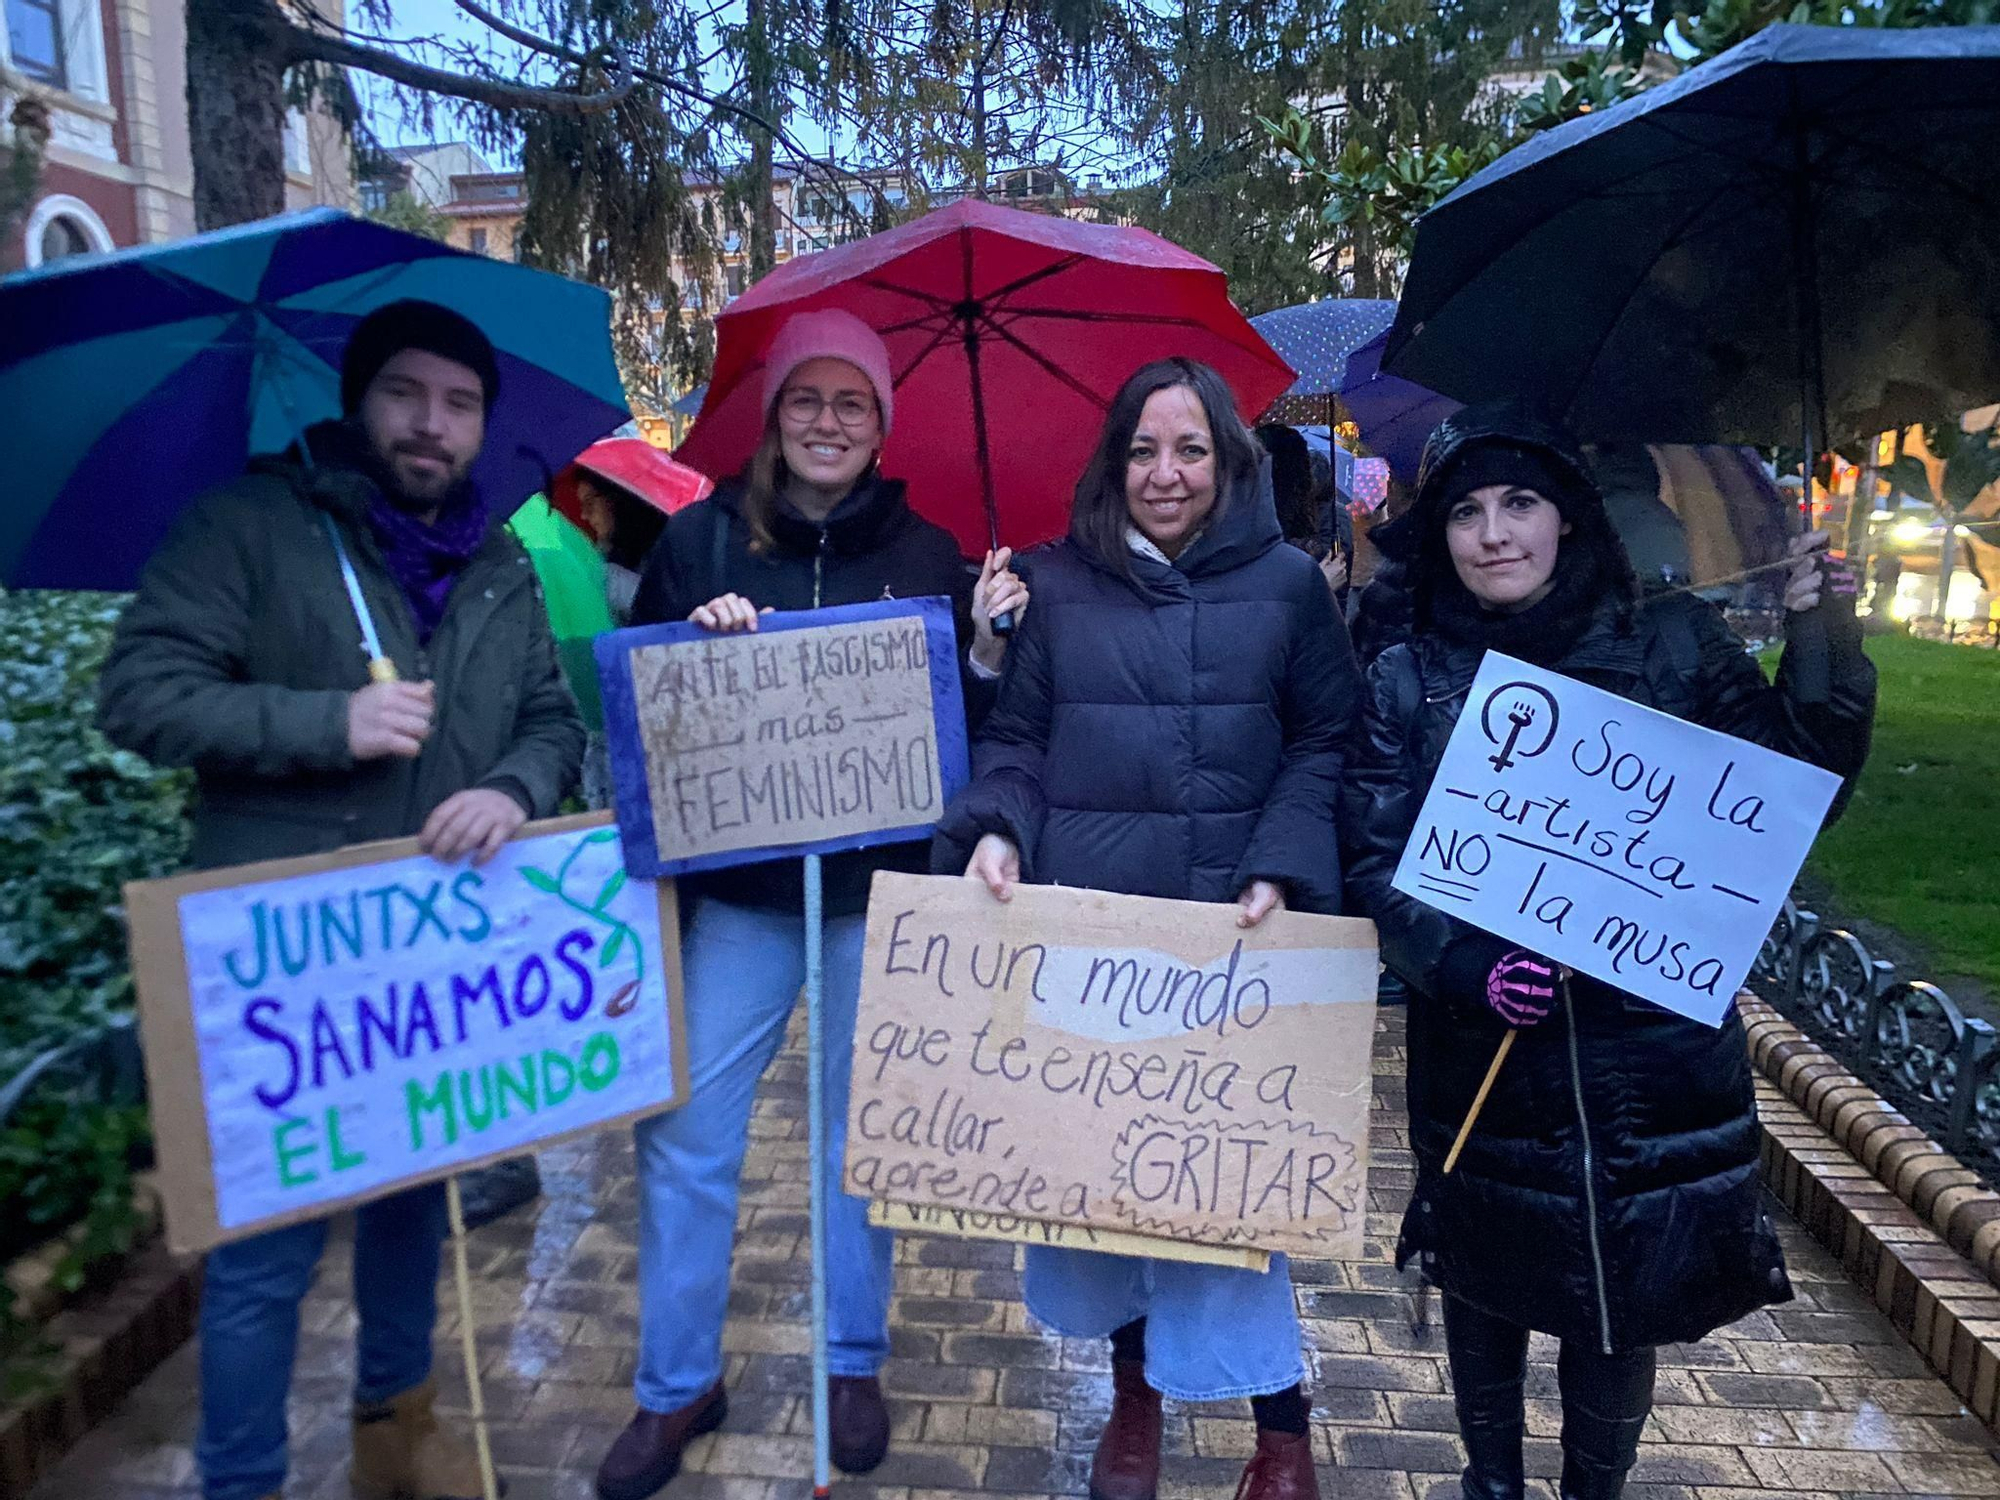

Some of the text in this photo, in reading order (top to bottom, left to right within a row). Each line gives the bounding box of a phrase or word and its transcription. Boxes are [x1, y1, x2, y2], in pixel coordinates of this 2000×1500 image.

[753, 645, 787, 691] EL
[673, 735, 933, 834] FEMINISMO
[1572, 720, 1765, 833] Soy la
[223, 870, 491, 988] JUNTXS
[1419, 825, 1724, 996] NO la musa
[243, 929, 594, 1109] SANAMOS
[886, 909, 1270, 1035] En un mundo
[273, 1031, 620, 1188] EL MUNDO
[869, 1018, 1294, 1114] que te enseña a
[852, 1131, 1352, 1221] aprende a GRITAR
